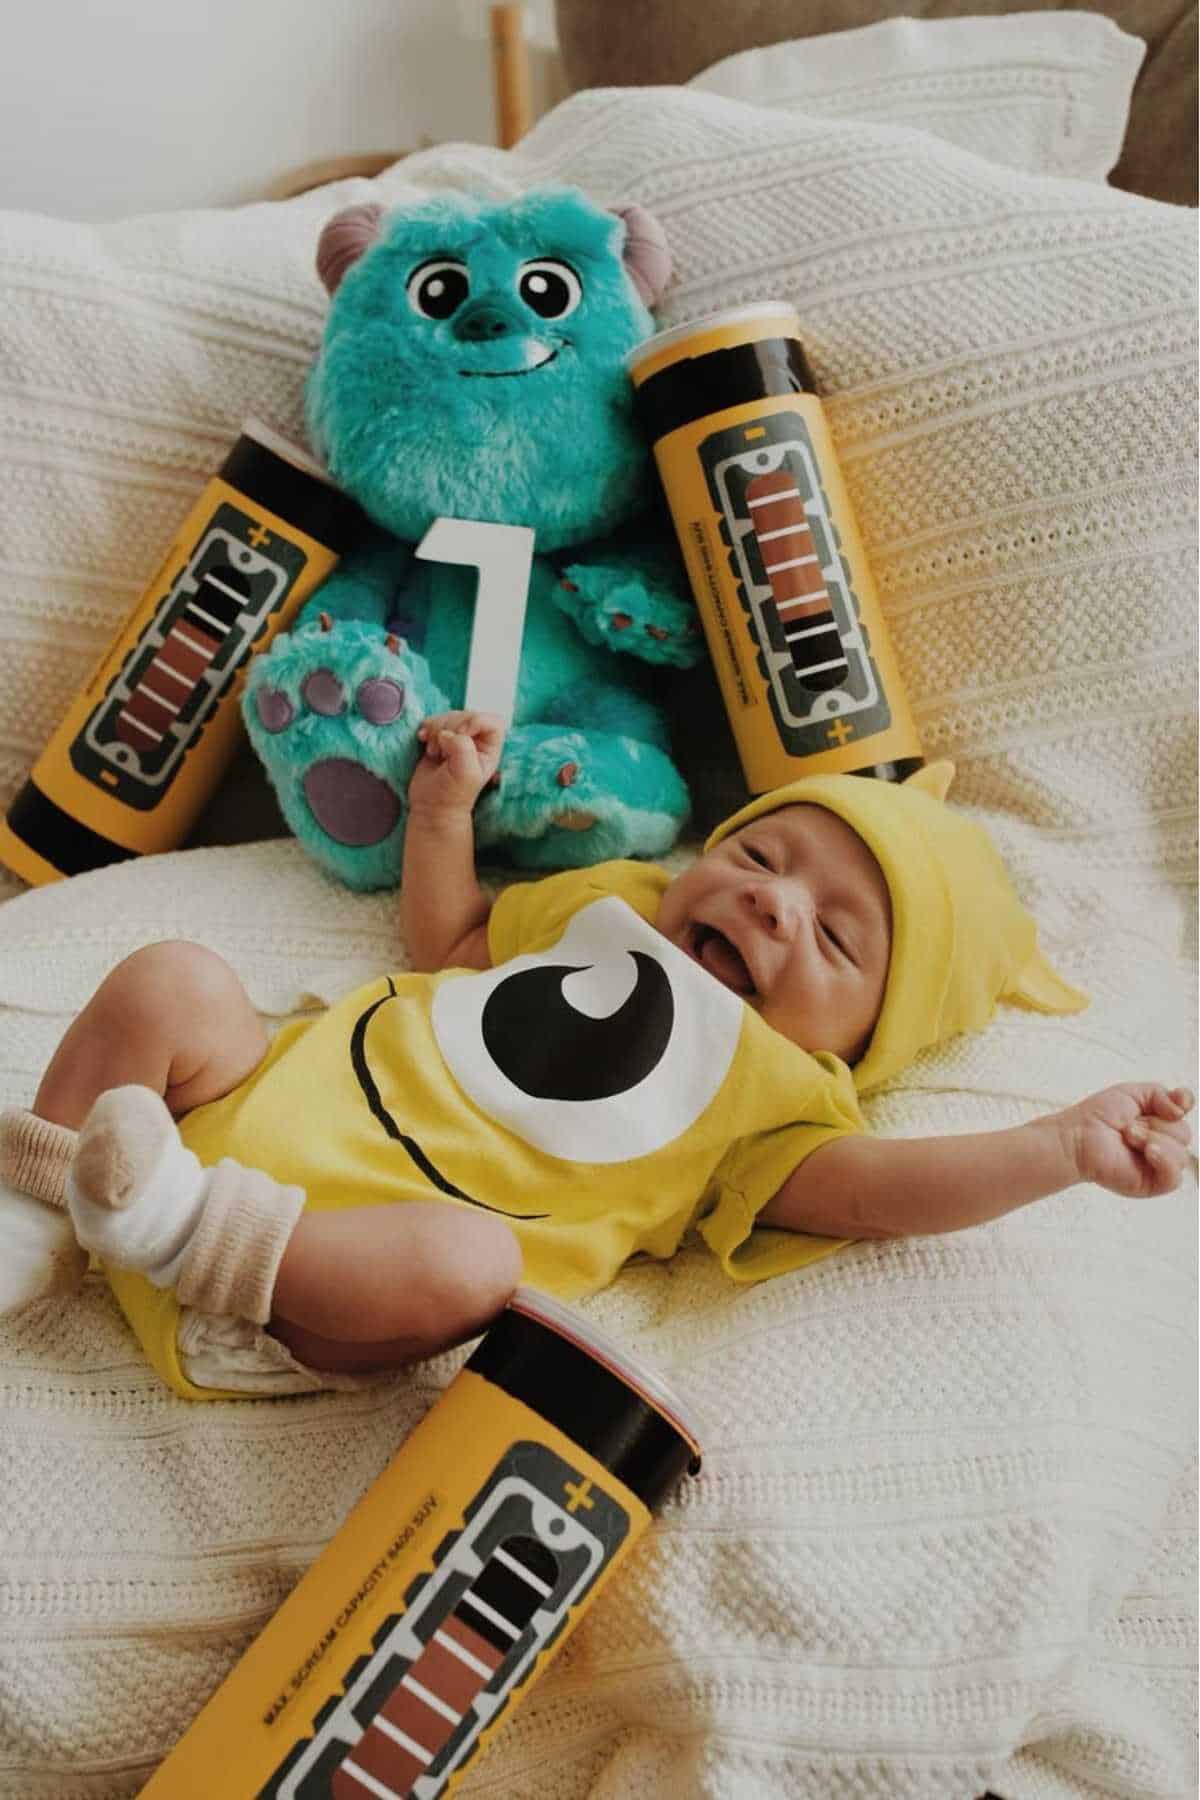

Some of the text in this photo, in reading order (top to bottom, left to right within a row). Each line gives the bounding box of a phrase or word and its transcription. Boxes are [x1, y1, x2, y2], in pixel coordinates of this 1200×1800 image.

[415, 517, 535, 716] 1
[287, 1626, 340, 1691] SCREAM
[332, 1558, 391, 1631] CAPACITY
